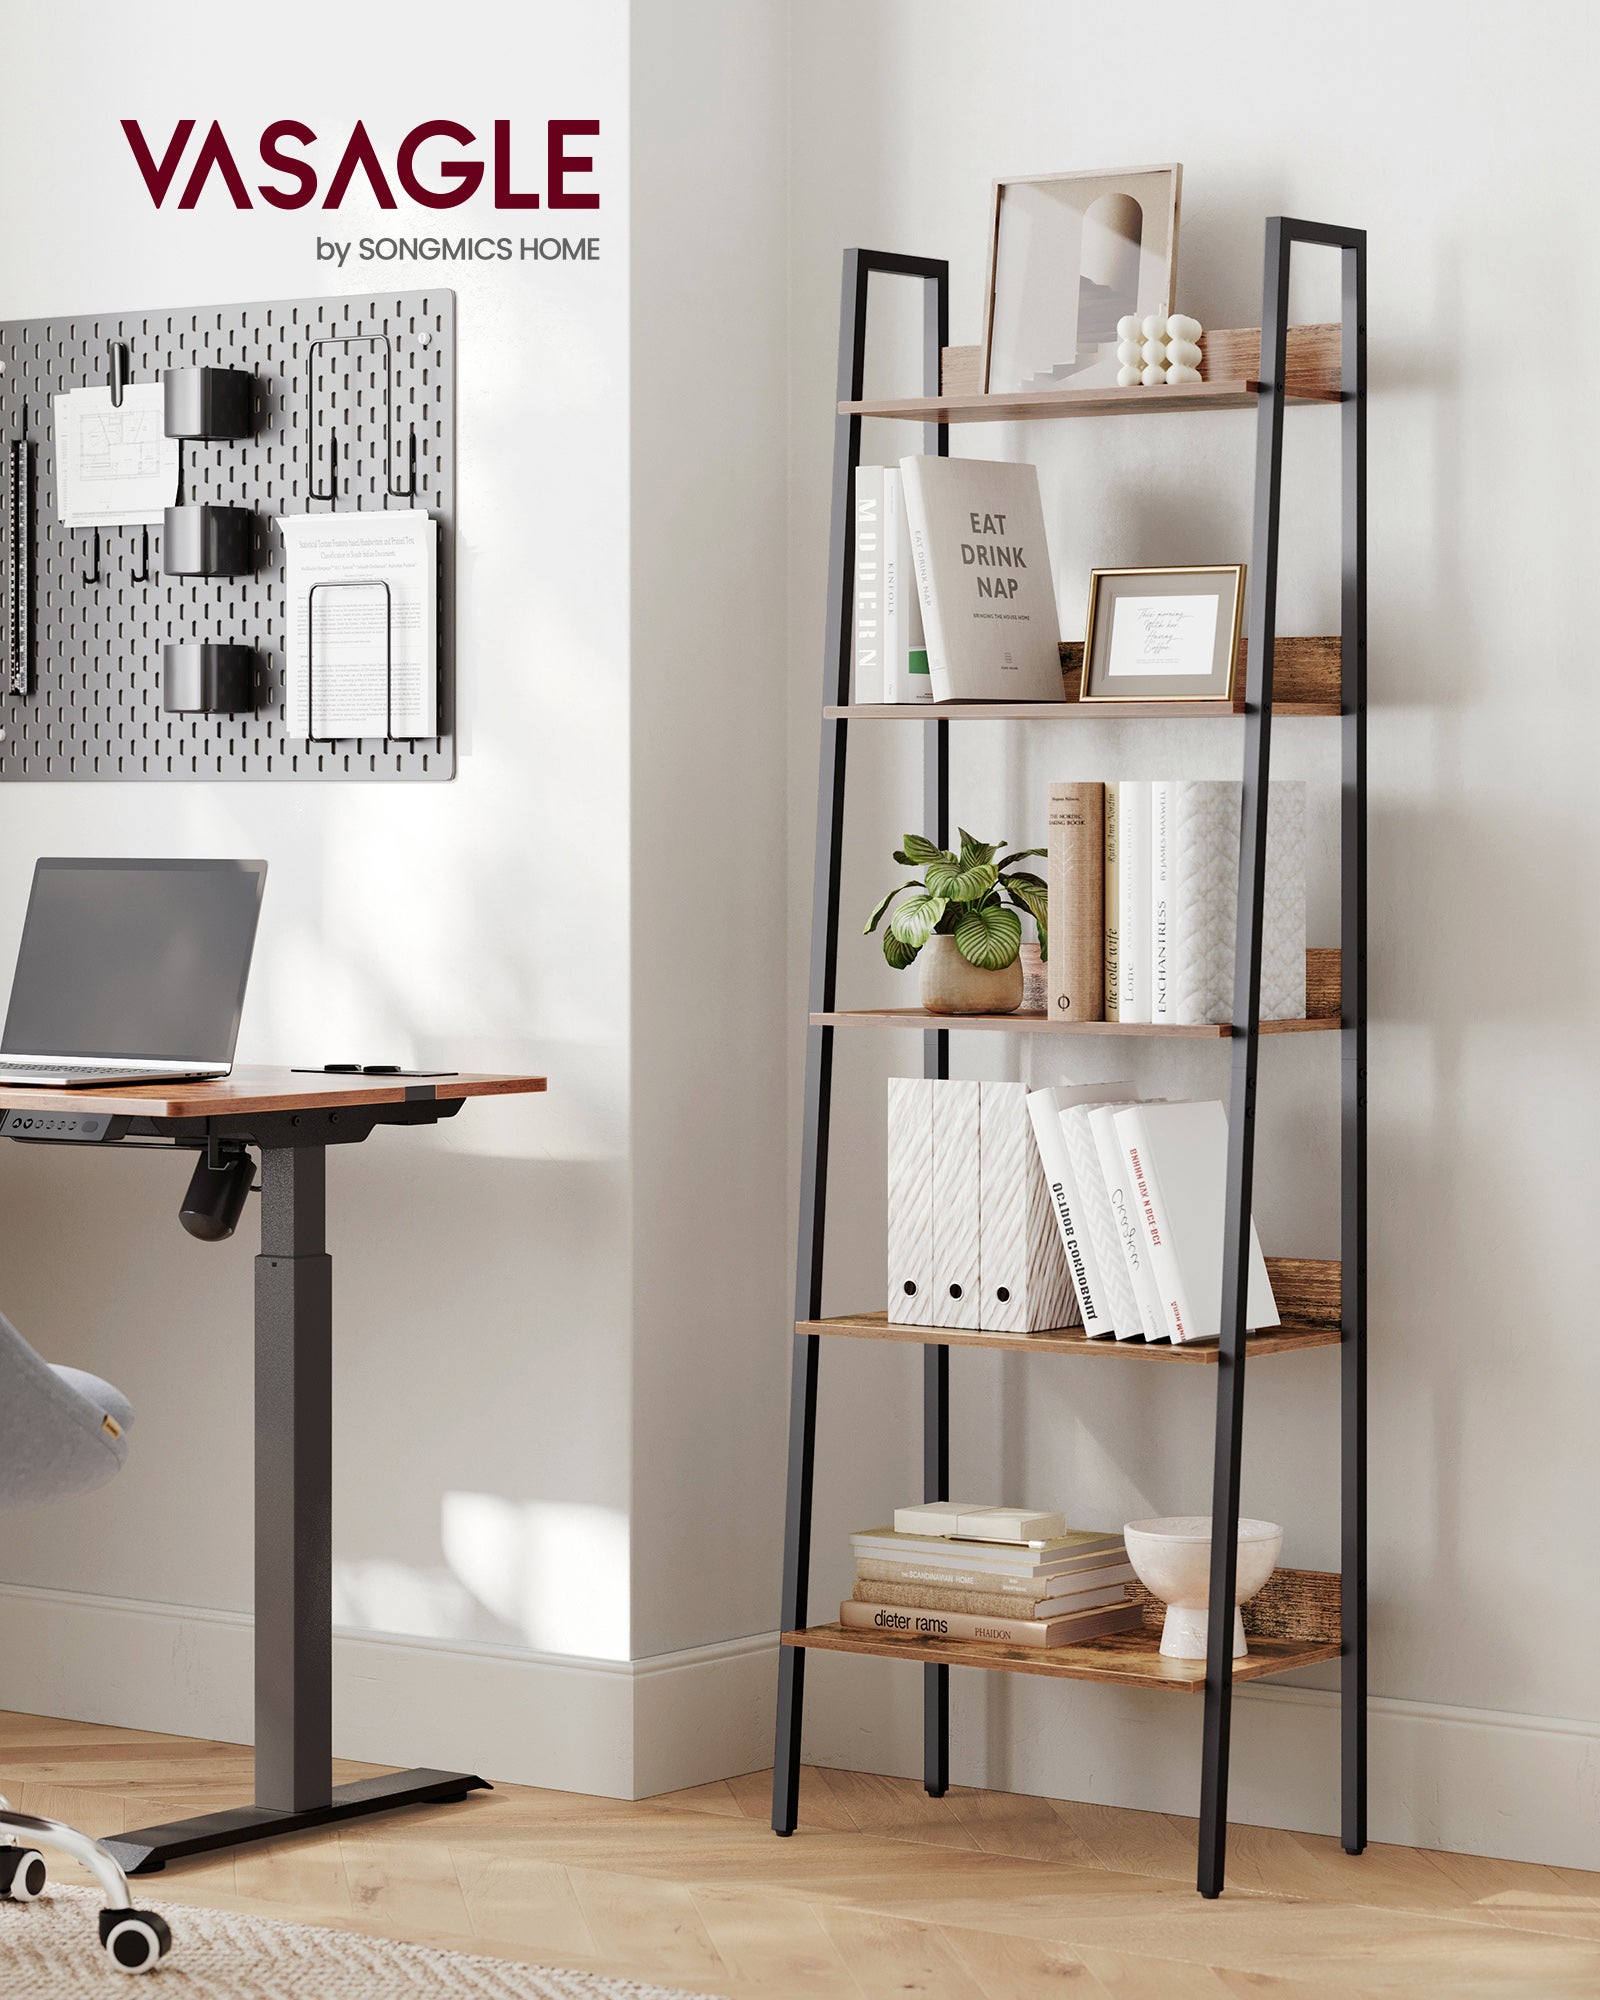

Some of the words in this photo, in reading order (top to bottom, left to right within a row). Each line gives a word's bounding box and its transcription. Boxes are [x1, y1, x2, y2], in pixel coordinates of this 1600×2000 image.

[970, 512, 1006, 535] EAT
[914, 530, 923, 550] EAT
[918, 551, 929, 583] DRINK
[961, 544, 1027, 568] DRINK
[858, 498, 877, 667] MODERN
[977, 576, 1018, 599] NAP
[923, 585, 932, 606] NAP
[1160, 838, 1168, 868] JAMES
[1160, 869, 1167, 881] BY
[1106, 928, 1119, 957] wife
[1158, 901, 1167, 1013] ENCHANTRESS
[1106, 960, 1118, 987] cold
[1106, 988, 1118, 1010] the
[956, 1576, 974, 1584] HOME
[874, 1610, 912, 1630] dieter
[915, 1617, 948, 1634] rams
[974, 1627, 1011, 1640] PHAIDON
